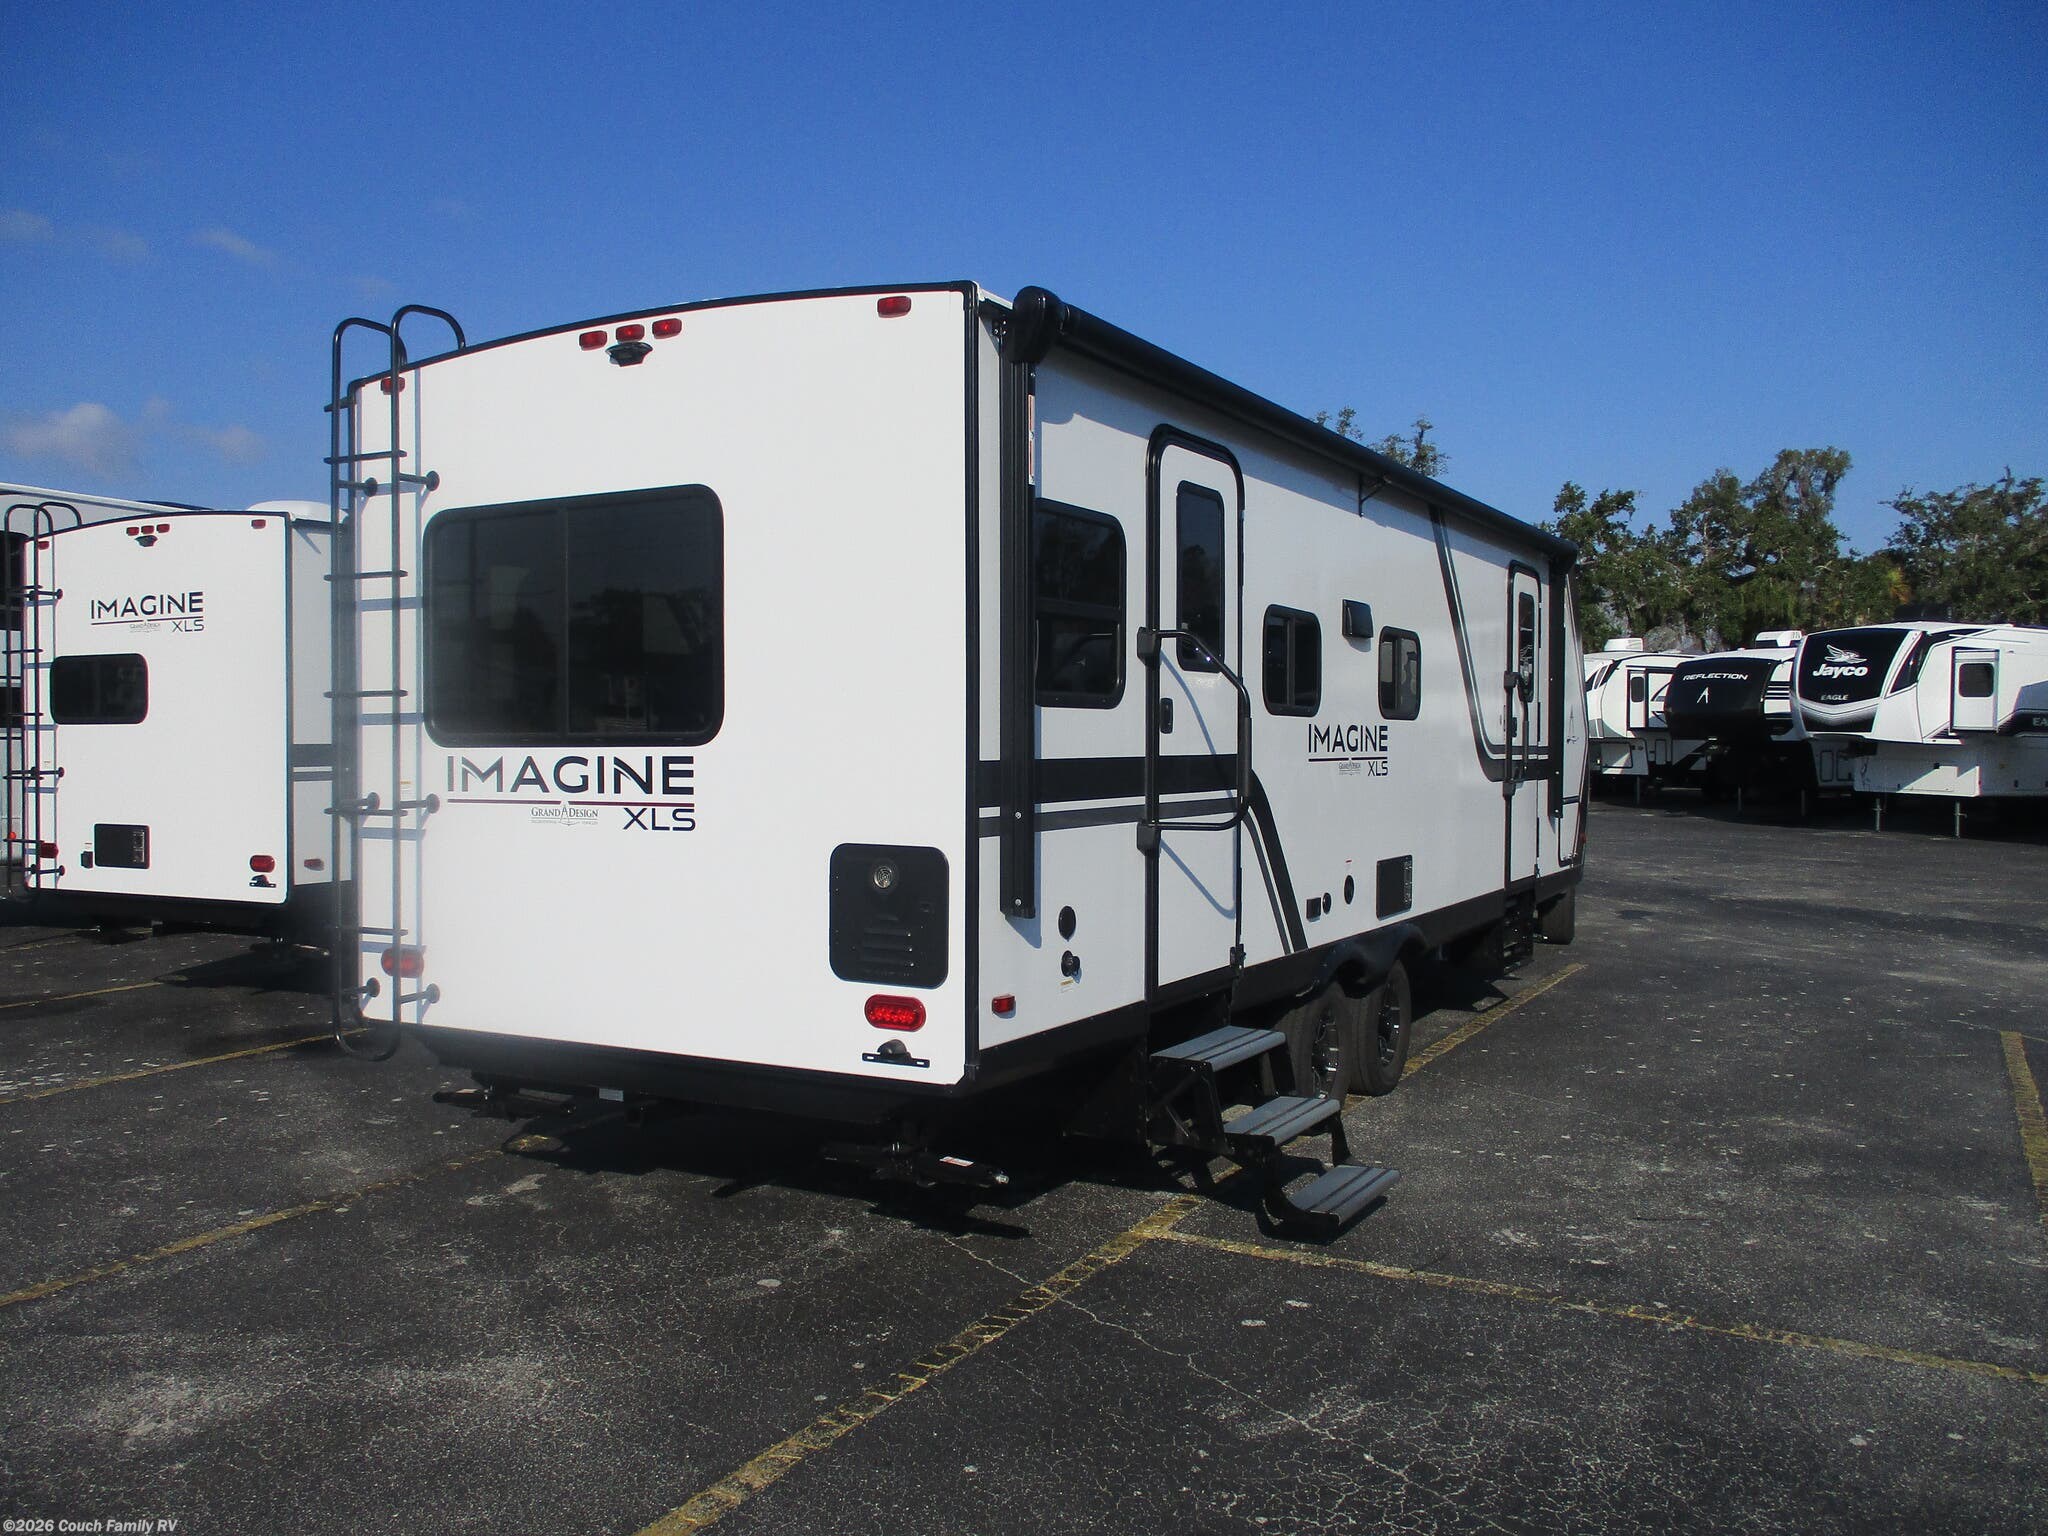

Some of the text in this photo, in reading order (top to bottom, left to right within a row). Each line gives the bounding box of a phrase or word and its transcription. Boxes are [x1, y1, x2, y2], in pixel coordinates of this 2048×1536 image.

[90, 591, 204, 619] IMAGINE
[172, 619, 205, 632] XLS
[1682, 672, 1749, 681] REFLECTION
[1812, 663, 1869, 679] Jayco
[1307, 723, 1389, 753] IMAGINE
[447, 755, 695, 796] IMAGINE
[1367, 760, 1389, 777] XLS
[622, 807, 697, 832] XLS
